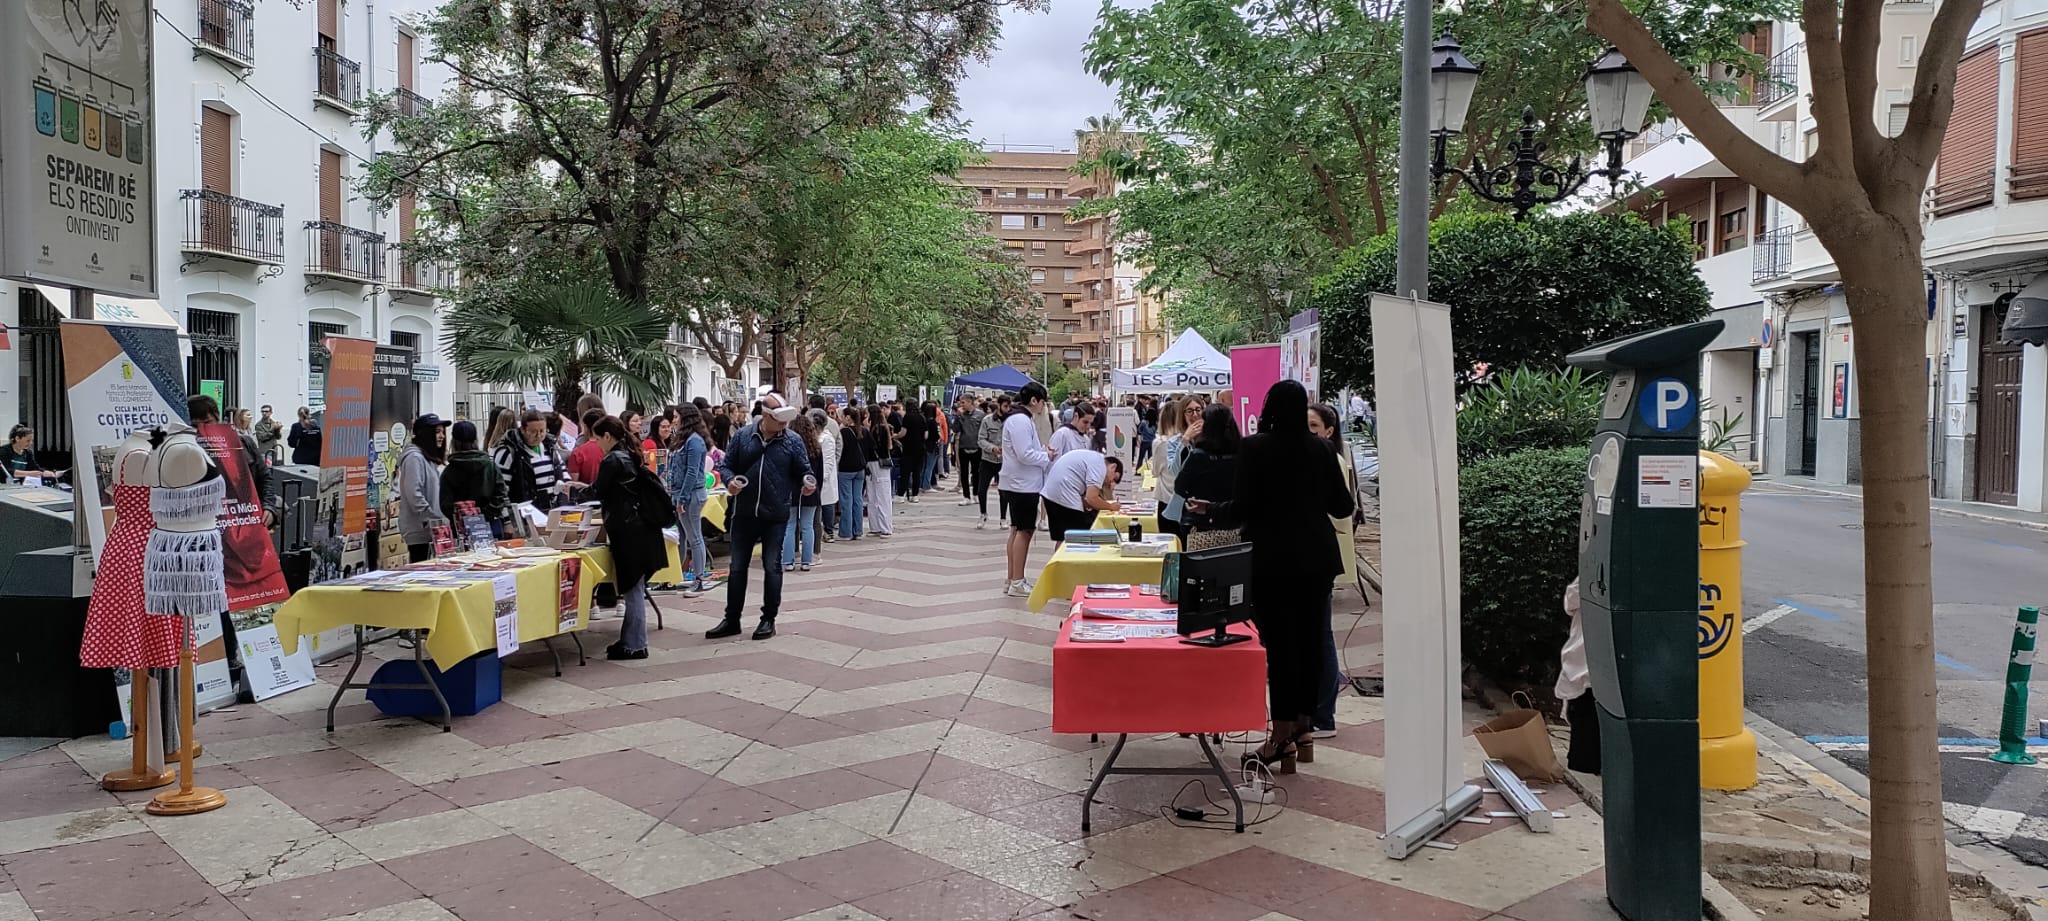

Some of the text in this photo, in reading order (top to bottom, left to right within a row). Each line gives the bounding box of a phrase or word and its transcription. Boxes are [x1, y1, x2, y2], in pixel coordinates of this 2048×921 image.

[46, 154, 137, 200] SEPAREM BÉ
[49, 182, 135, 224] ELS RESIDUS
[66, 215, 120, 243] ONTINYENT
[1132, 374, 1163, 386] IES
[1176, 373, 1209, 387] Pou
[97, 410, 169, 426] CONFECCIÓ
[1656, 381, 1689, 429] P
[115, 428, 120, 440] I
